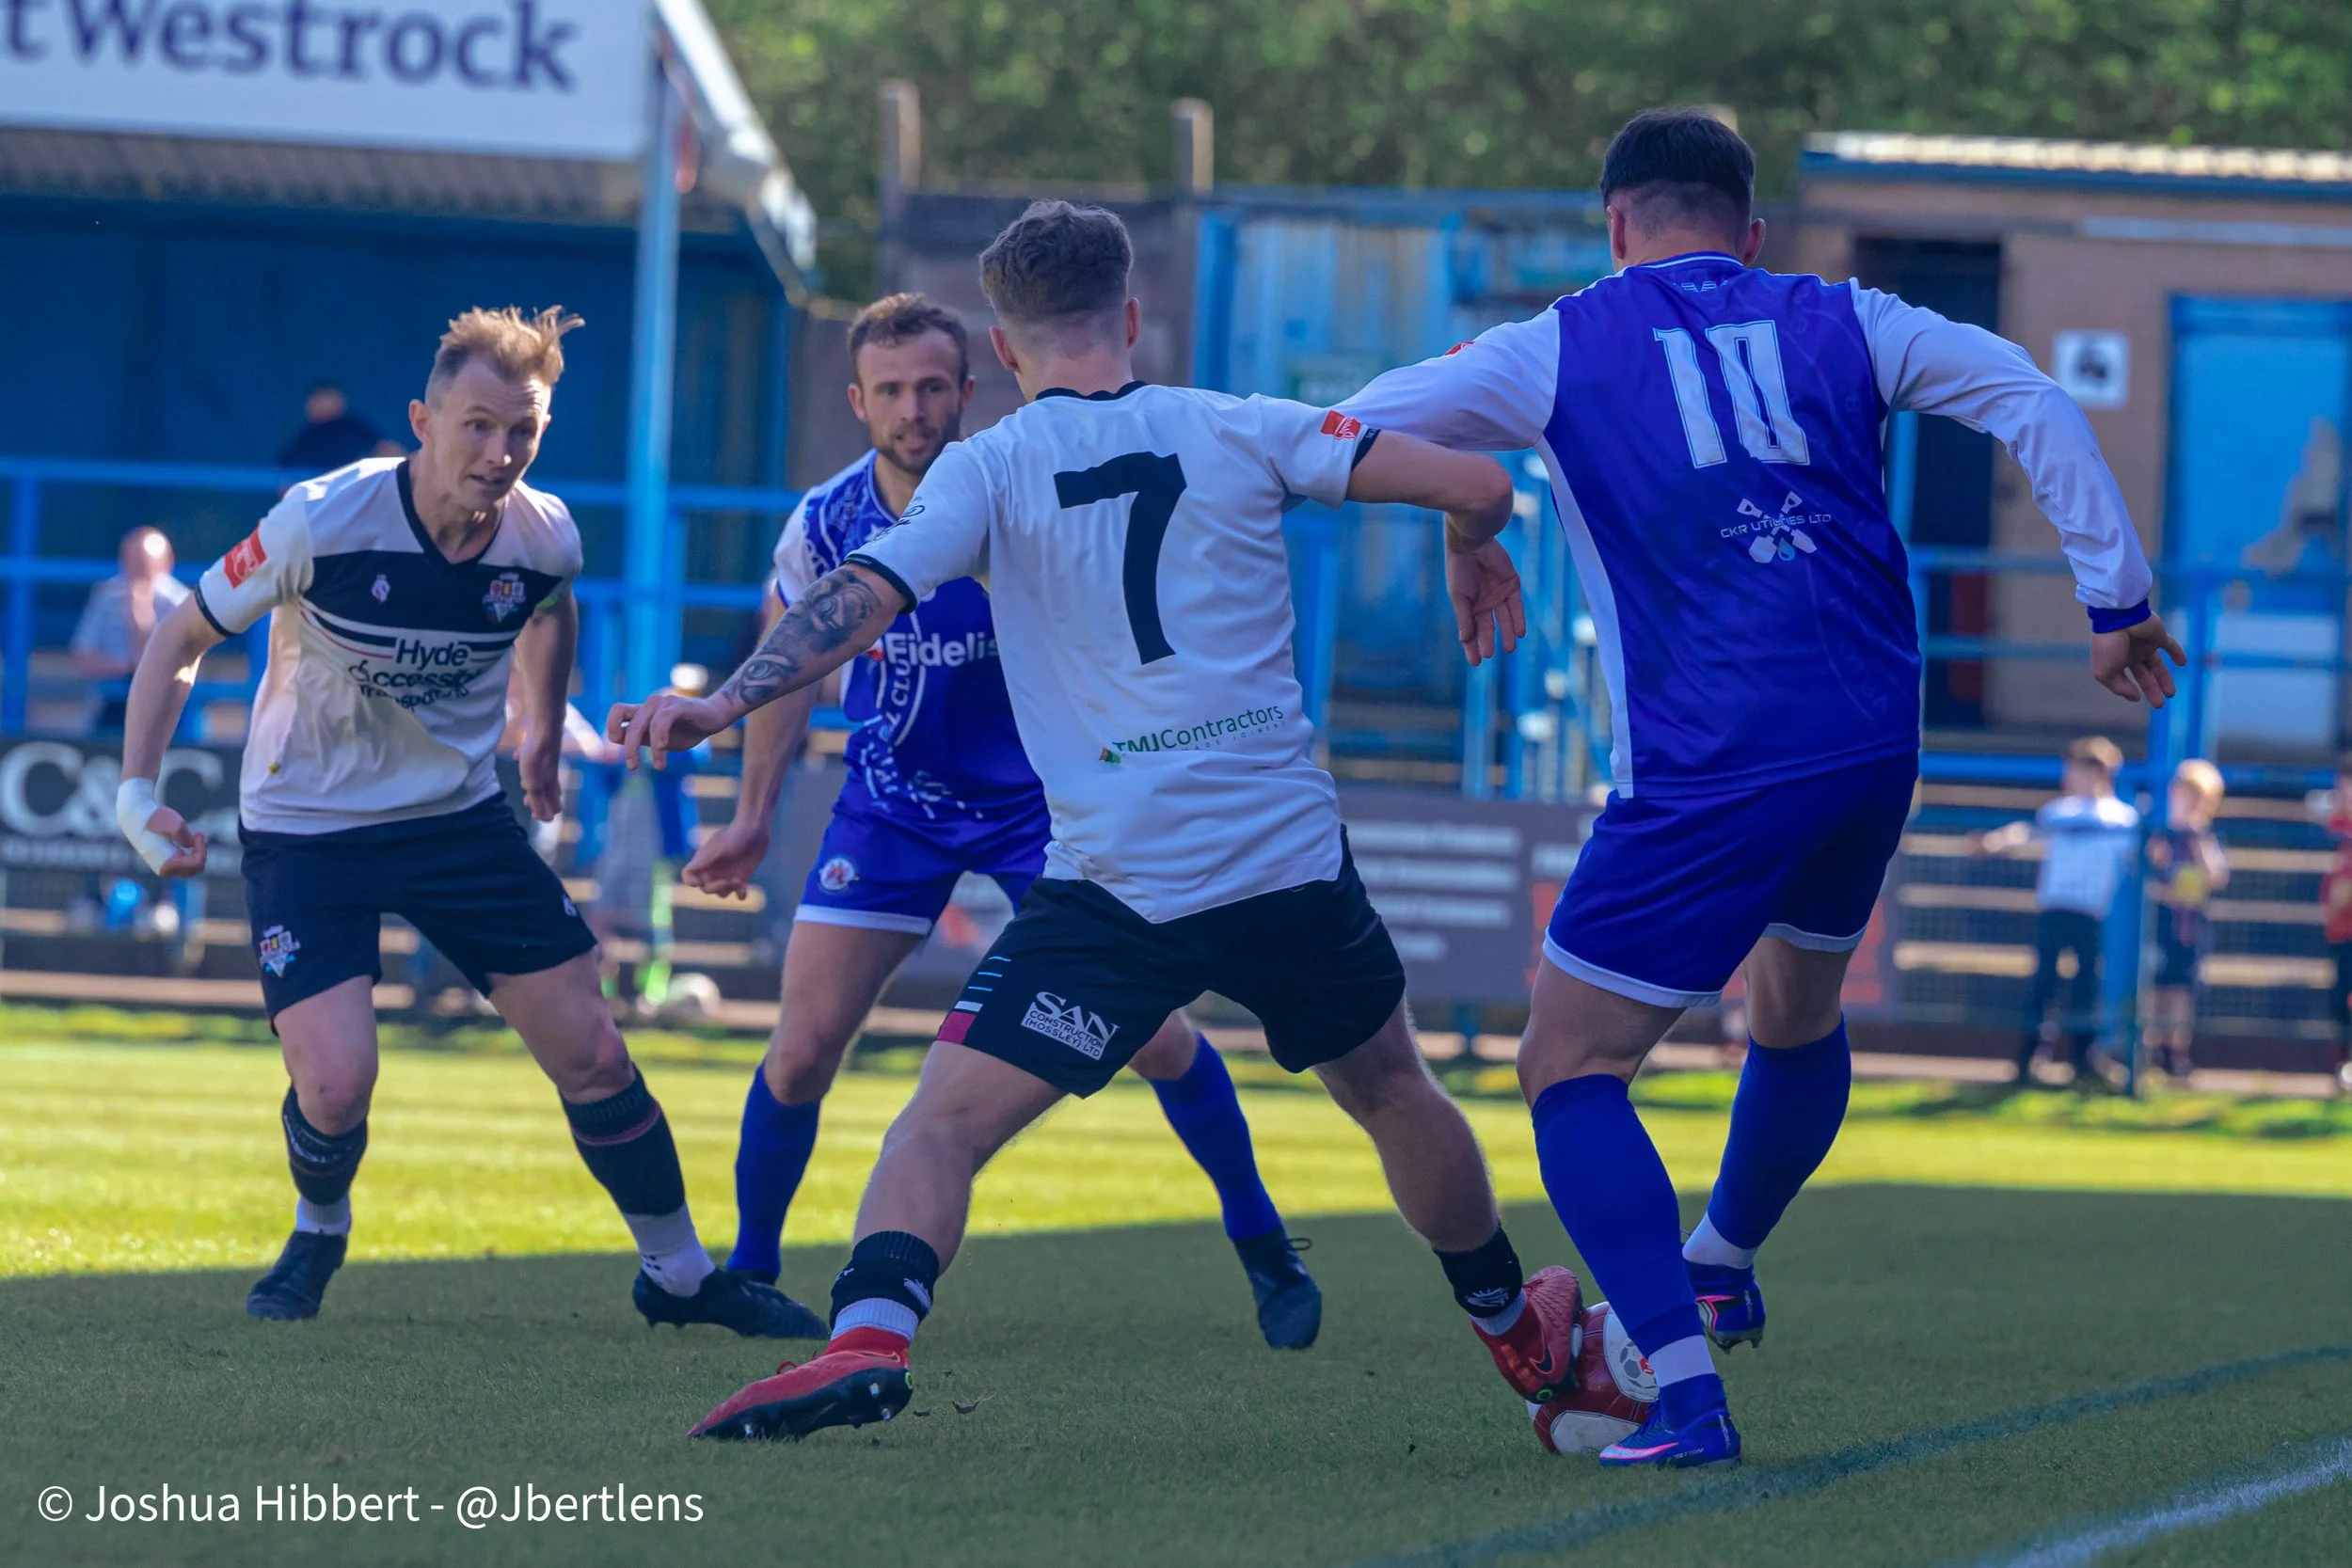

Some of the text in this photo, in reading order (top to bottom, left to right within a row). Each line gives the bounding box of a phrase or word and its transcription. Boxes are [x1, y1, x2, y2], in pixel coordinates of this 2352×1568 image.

[1652, 320, 1810, 468] 10
[1720, 524, 1748, 538] CKR
[1809, 514, 1832, 524] LTD
[1054, 451, 1187, 665] 7
[395, 639, 468, 671] Hyde
[1029, 1010, 1104, 1049] CONSTRUCTION
[1035, 990, 1120, 1042] SAN
[1025, 1017, 1102, 1058] (MOSSLEY) LTD
